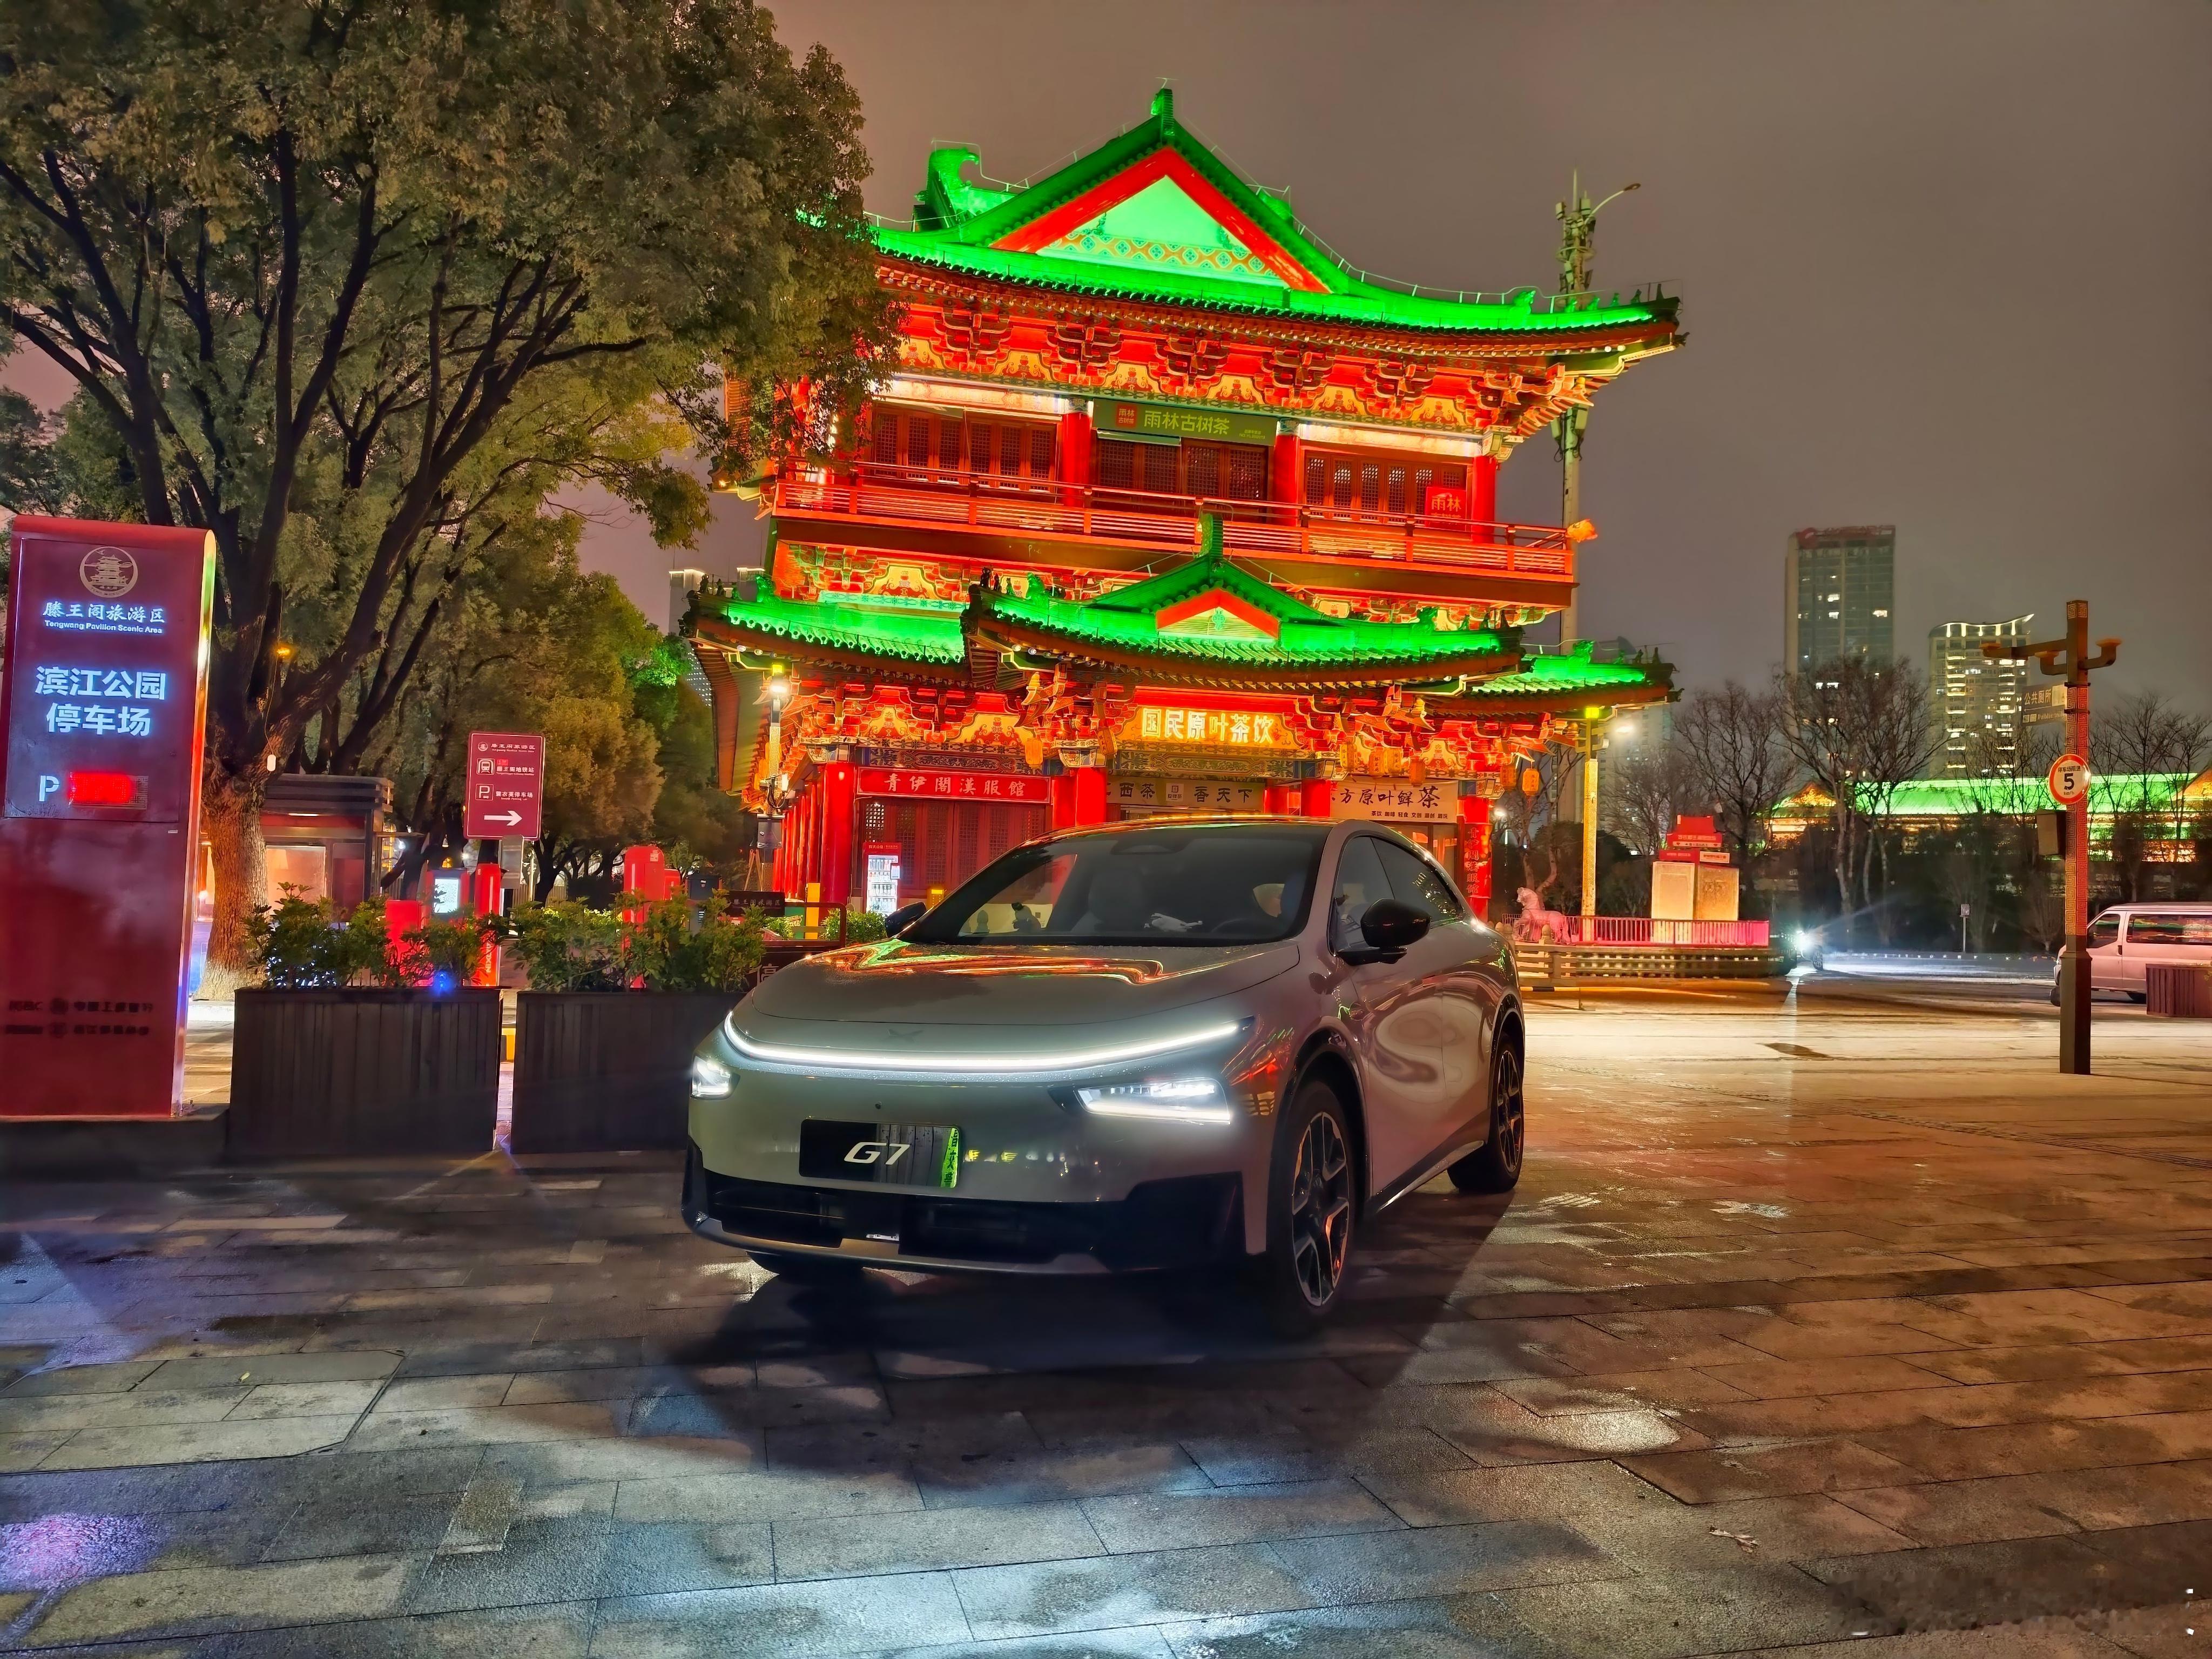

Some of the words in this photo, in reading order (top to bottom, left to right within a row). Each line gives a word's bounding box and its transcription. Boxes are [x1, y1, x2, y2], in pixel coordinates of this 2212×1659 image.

[1144, 410, 1230, 435] 雨林古树茶
[1431, 495, 1462, 512] 雨林
[42, 601, 165, 623] 滕王阁旅游区
[45, 620, 84, 630] Tengwang
[86, 622, 116, 631] Pavilion
[118, 624, 143, 633] Scenic
[35, 666, 166, 700] 滨江公园
[2024, 689, 2052, 705] 公共厕所
[46, 703, 151, 737] 停车场
[1142, 708, 1274, 744] 国民原叶茶饮
[39, 775, 60, 802] P
[2064, 773, 2074, 790] 5
[1194, 786, 1252, 803] 香天下
[1332, 785, 1440, 808] 方原叶鲜茶
[844, 1142, 911, 1165] G7
